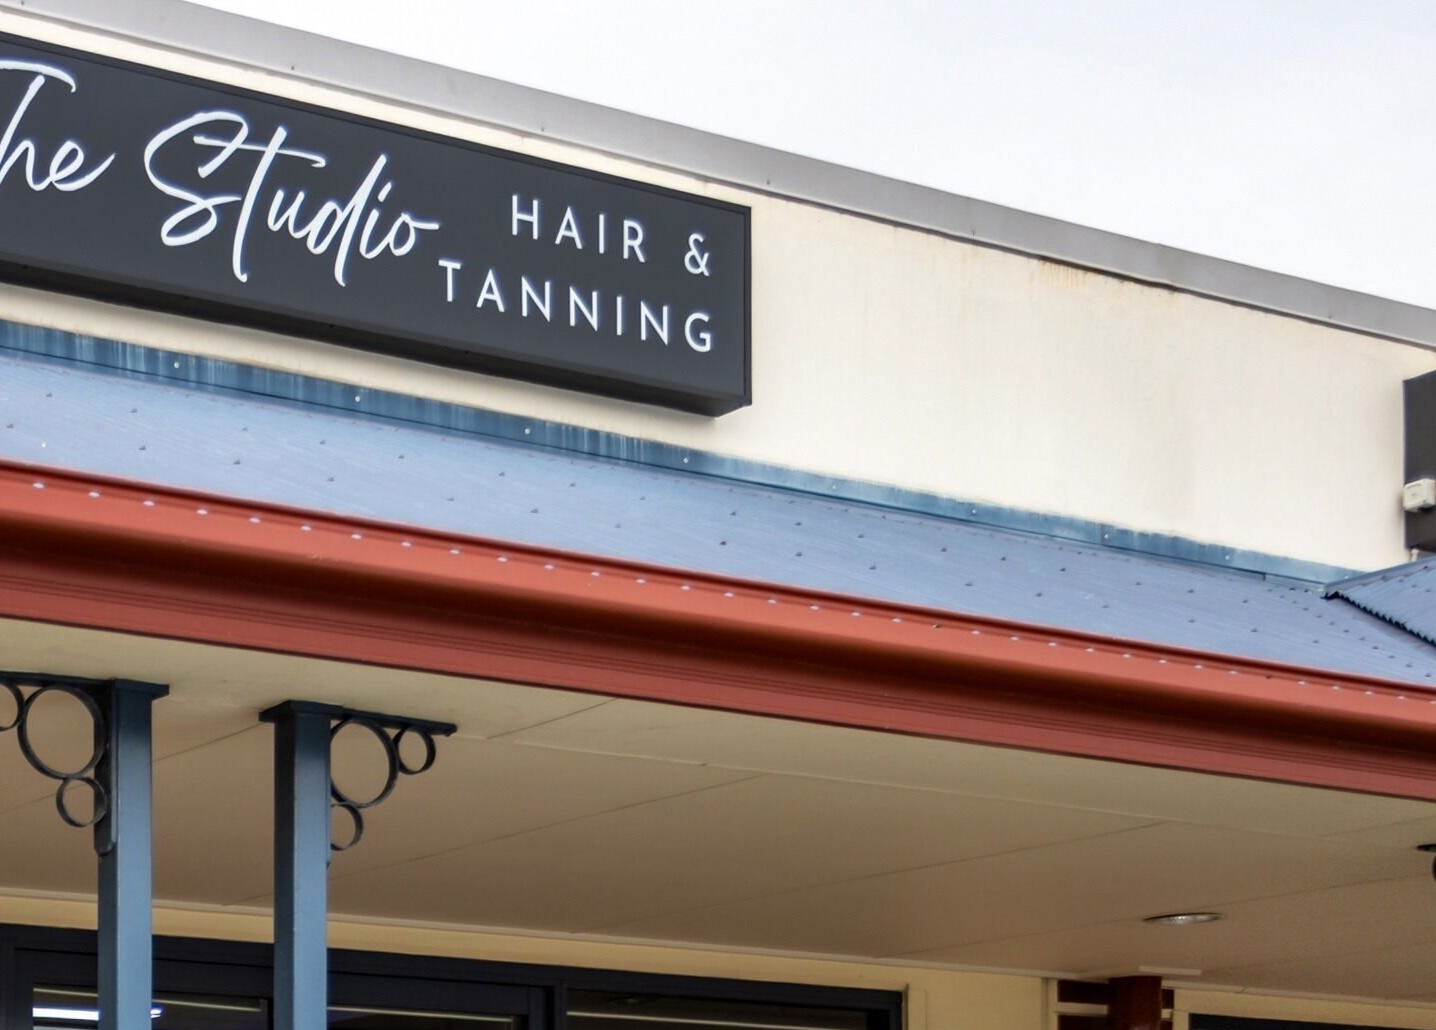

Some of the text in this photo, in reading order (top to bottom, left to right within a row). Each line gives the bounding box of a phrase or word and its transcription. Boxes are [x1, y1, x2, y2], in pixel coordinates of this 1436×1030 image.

[143, 110, 440, 288] Studio
[511, 194, 713, 277] HAIR &
[438, 259, 715, 354] TANNING
